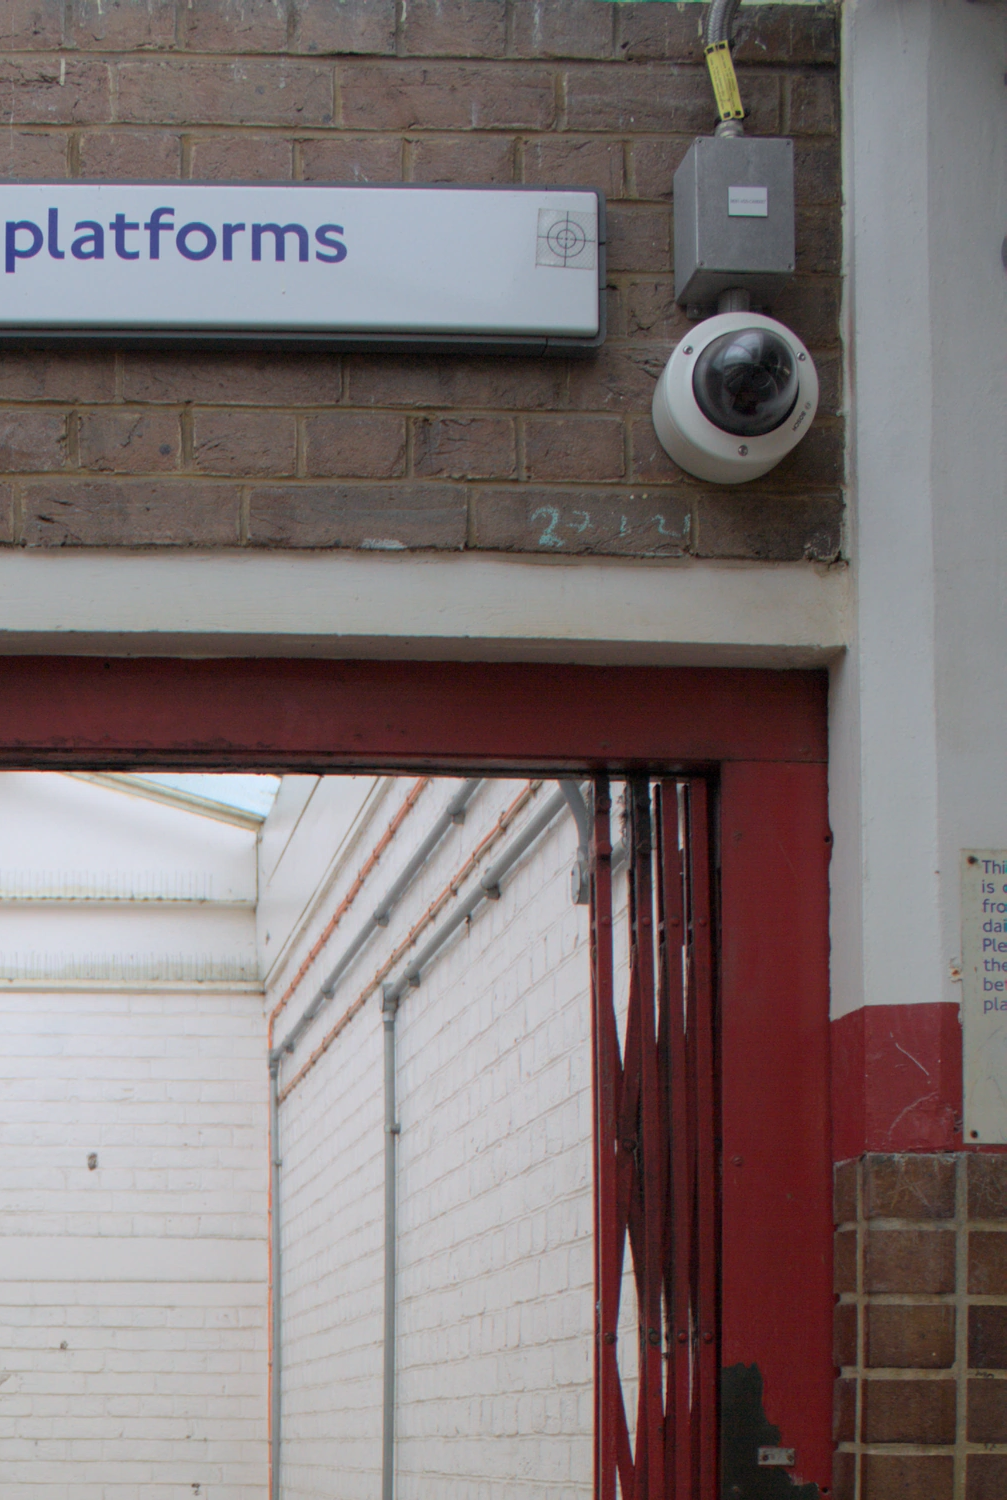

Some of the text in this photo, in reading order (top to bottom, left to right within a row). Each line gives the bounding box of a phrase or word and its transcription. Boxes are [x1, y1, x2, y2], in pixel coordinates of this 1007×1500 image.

[5, 207, 347, 274] platforms
[982, 879, 995, 893] is
[982, 898, 1007, 913] fro
[982, 937, 1007, 952] Ple
[983, 997, 1007, 1014] pla
